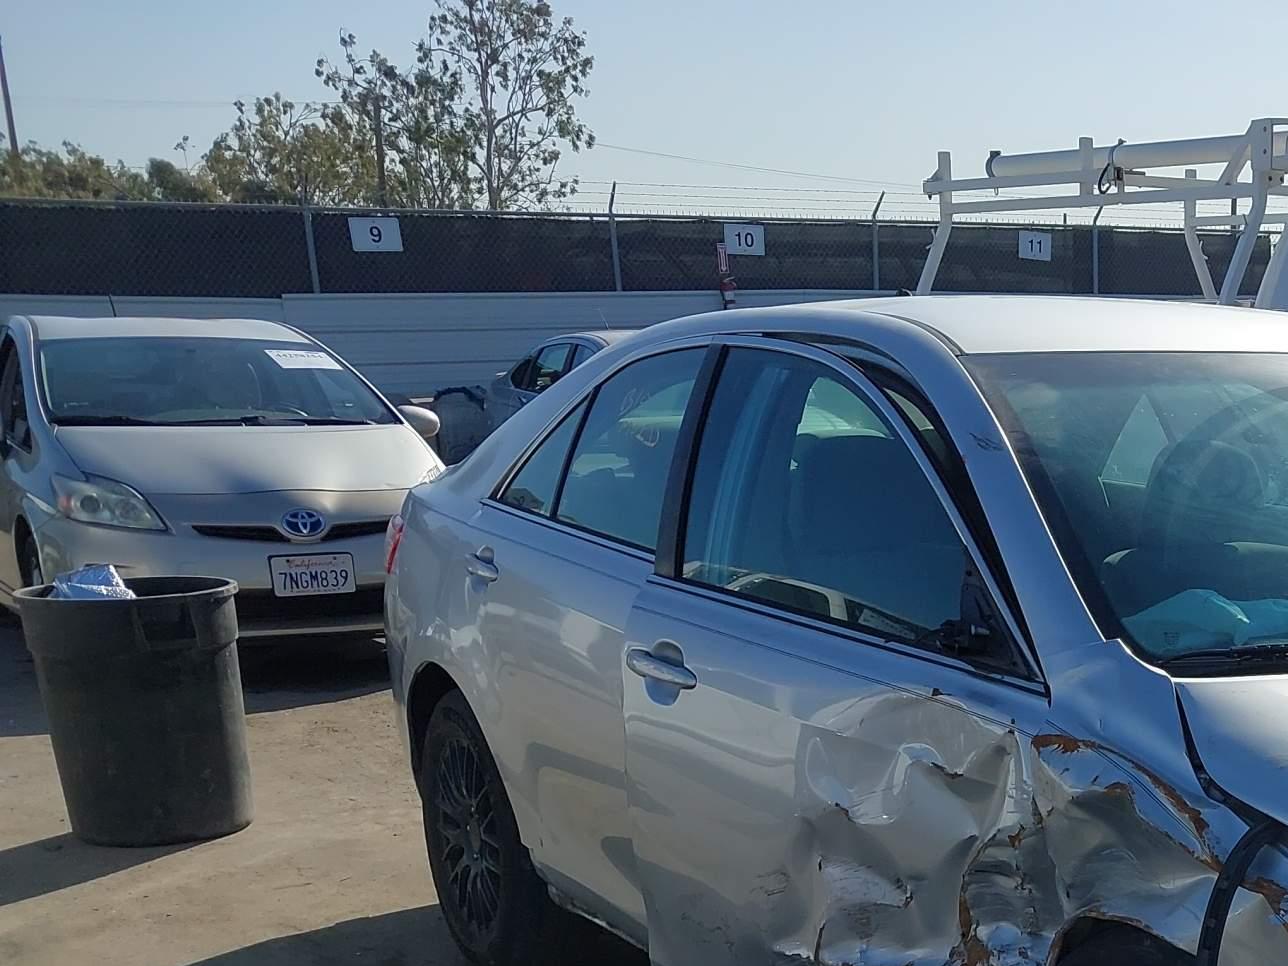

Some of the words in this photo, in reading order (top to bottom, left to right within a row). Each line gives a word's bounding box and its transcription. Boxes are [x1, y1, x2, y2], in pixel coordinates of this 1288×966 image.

[370, 226, 382, 243] 9
[735, 231, 754, 247] 10
[1028, 239, 1042, 253] 11
[278, 569, 349, 591] 7NGM839
